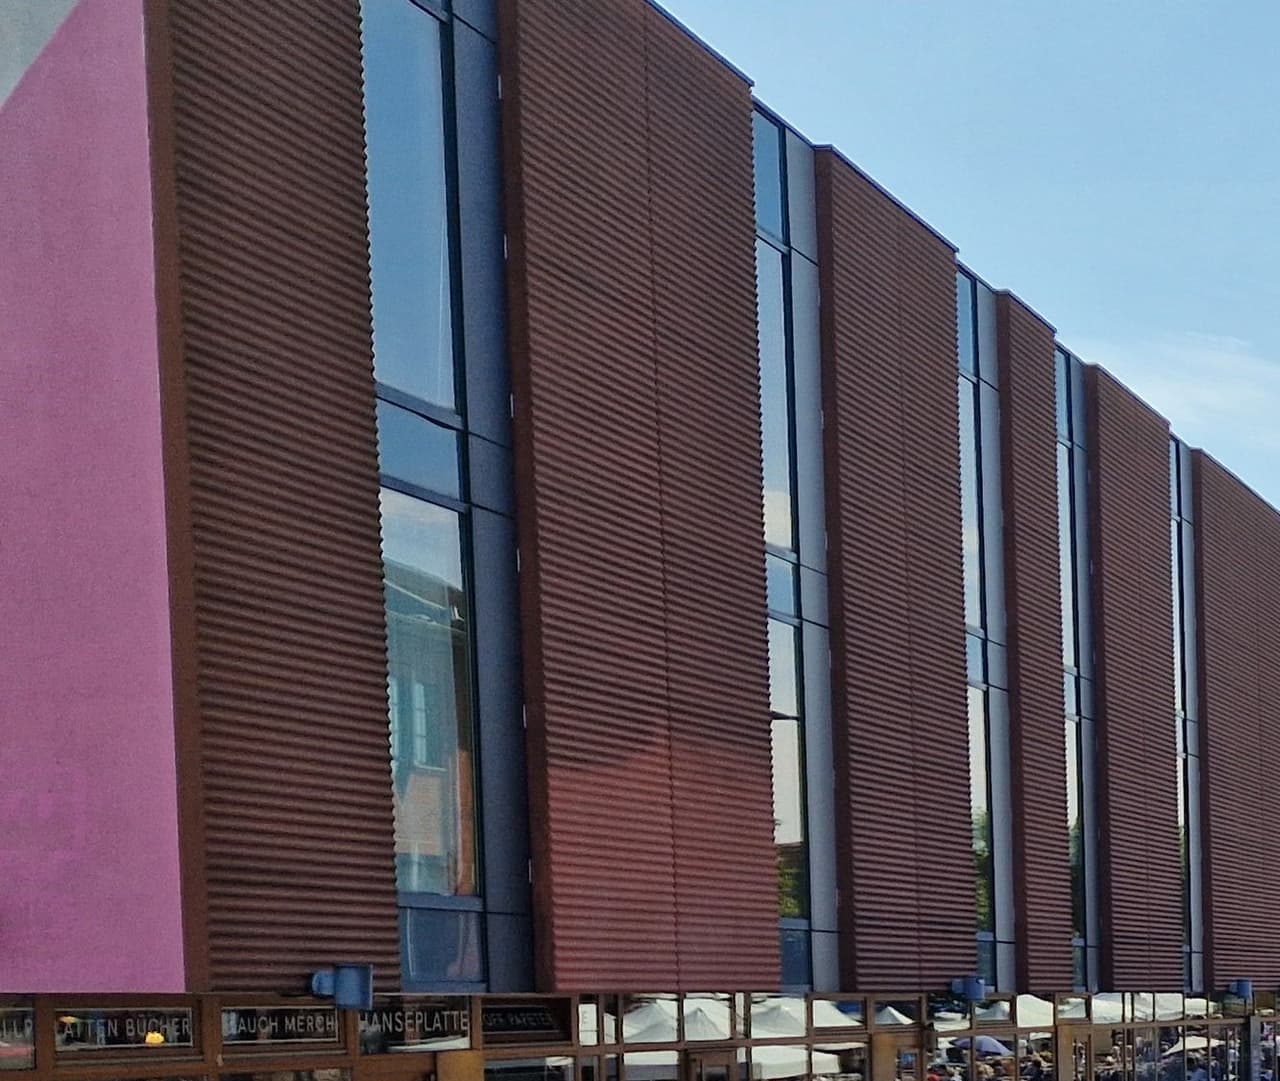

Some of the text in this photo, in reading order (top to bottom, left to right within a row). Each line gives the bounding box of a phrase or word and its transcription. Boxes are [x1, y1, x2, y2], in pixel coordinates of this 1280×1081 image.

[237, 1015, 336, 1033] AUCH MERCH
[358, 1010, 469, 1033] HANSEPLATTE
